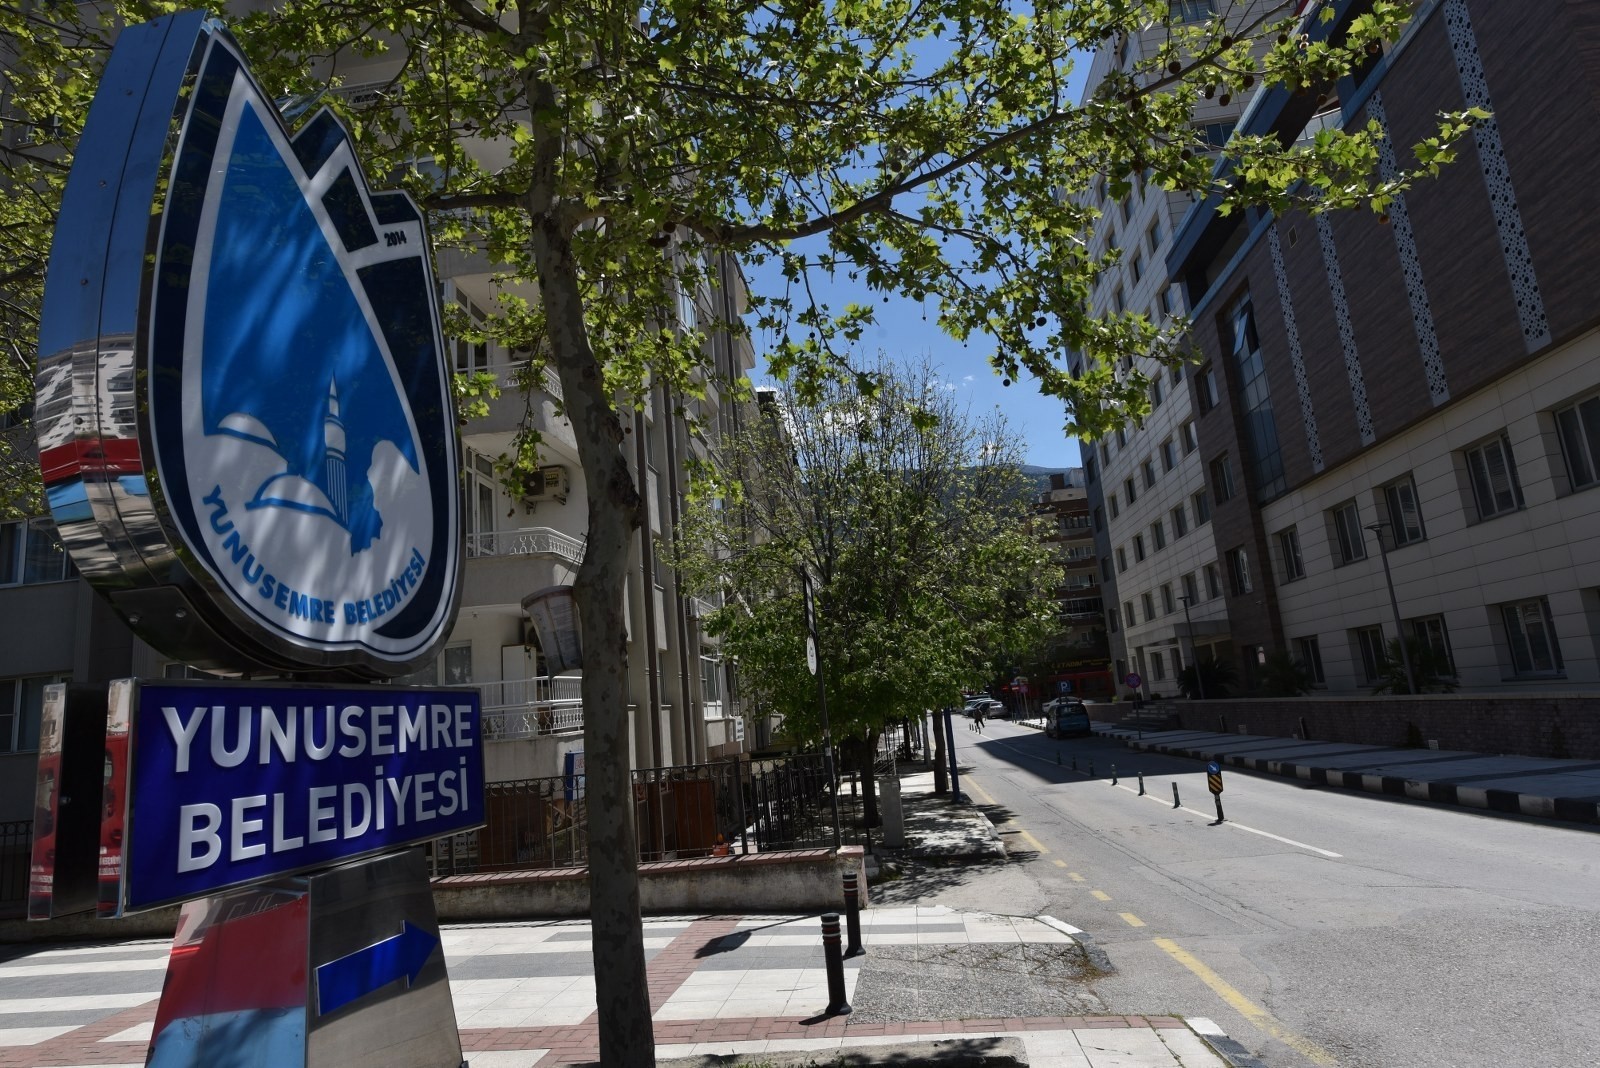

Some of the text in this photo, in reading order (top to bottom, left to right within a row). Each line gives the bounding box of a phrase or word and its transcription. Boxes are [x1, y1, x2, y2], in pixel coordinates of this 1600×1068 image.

[384, 230, 407, 247] 2014
[202, 484, 335, 624] YUNUSEMRE
[161, 704, 473, 773] YUNUSEMRE
[177, 756, 469, 873] BELEDİYESİ
